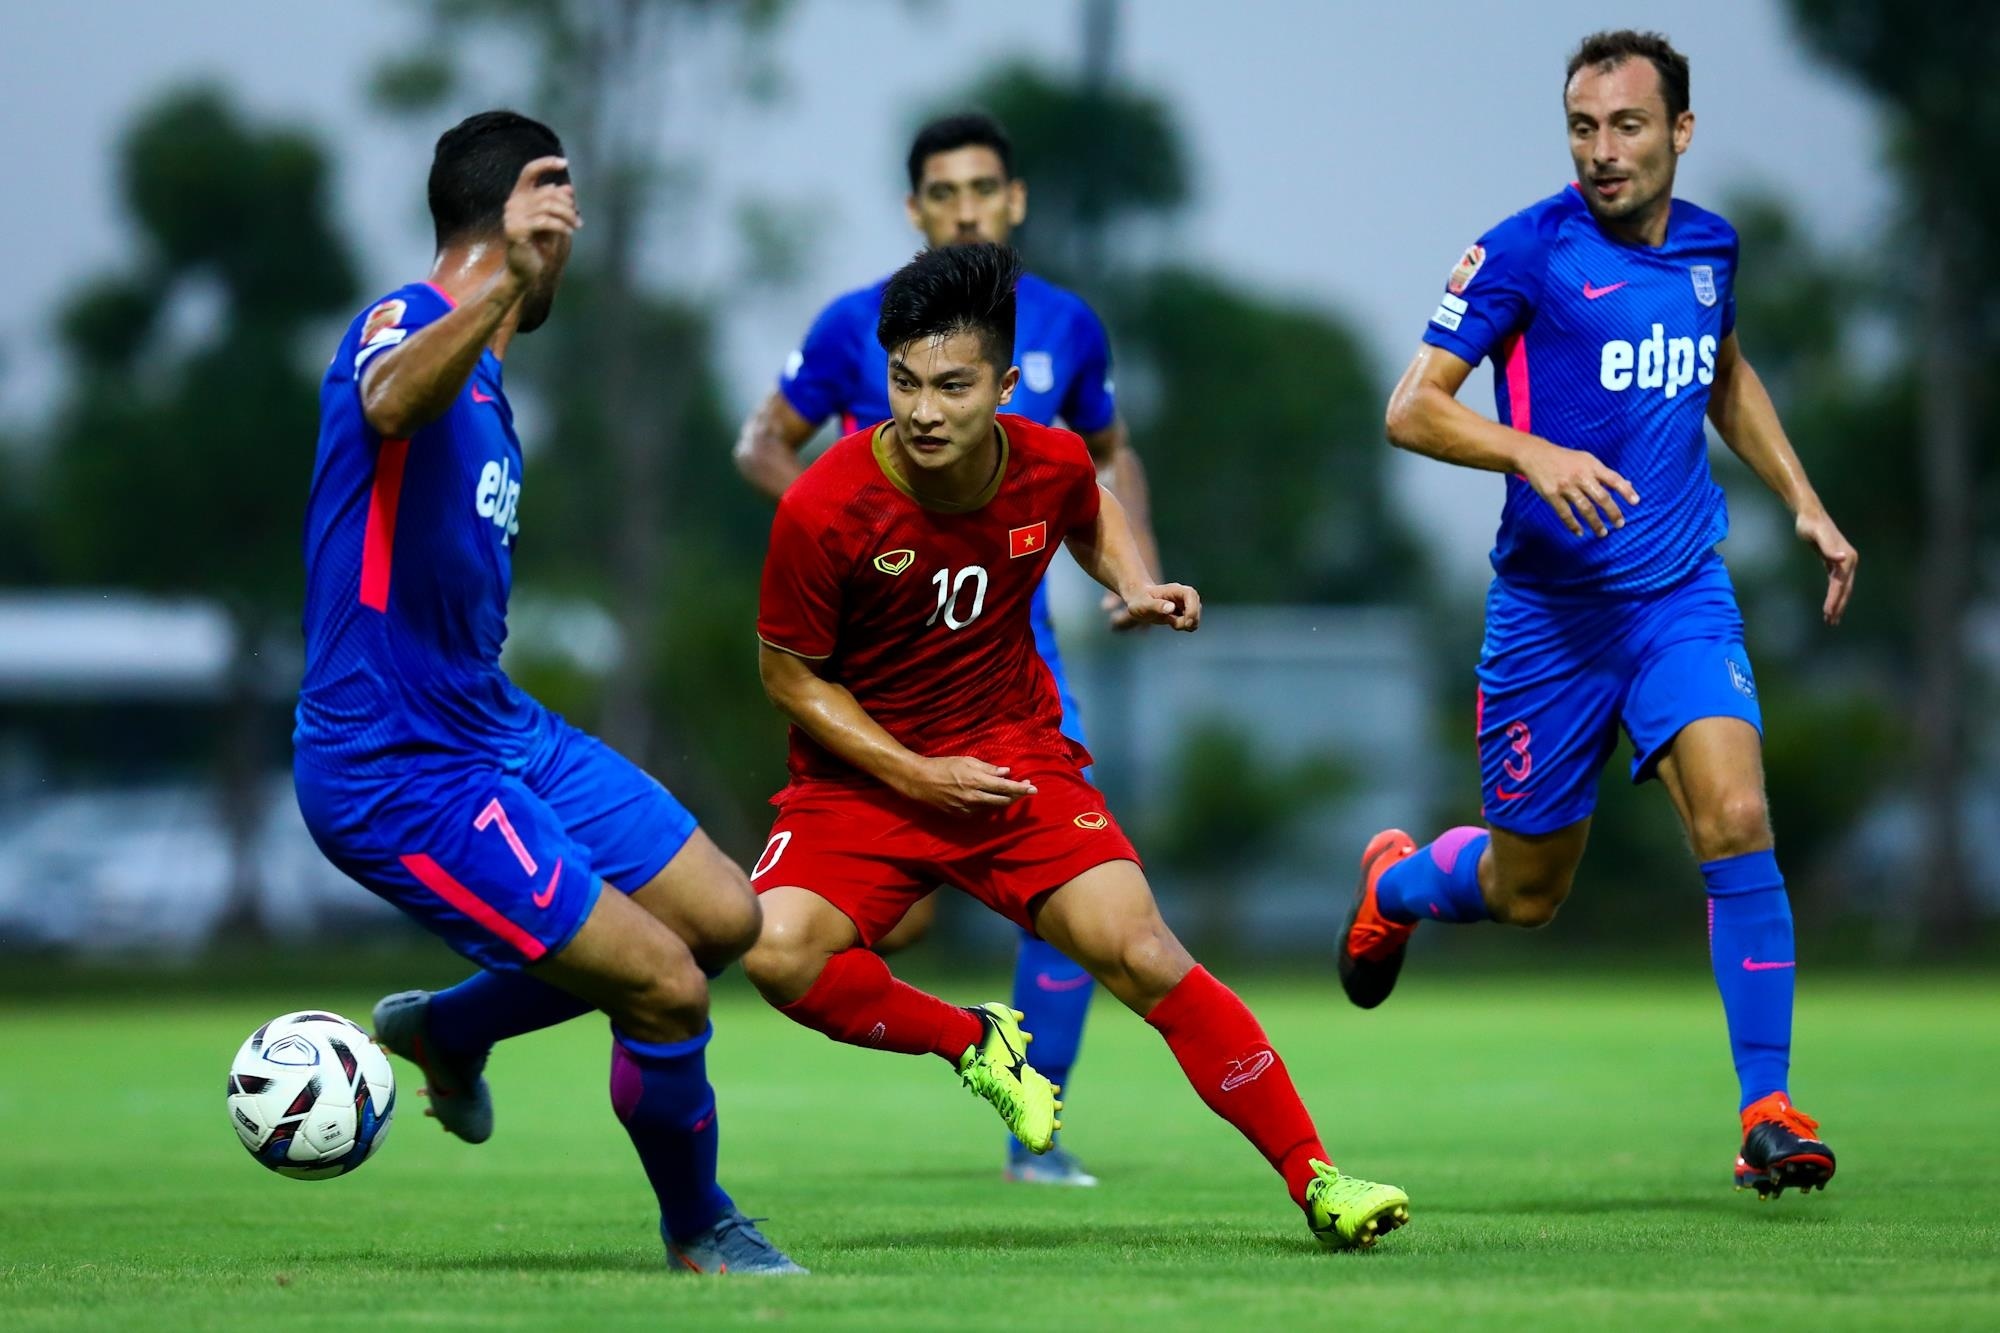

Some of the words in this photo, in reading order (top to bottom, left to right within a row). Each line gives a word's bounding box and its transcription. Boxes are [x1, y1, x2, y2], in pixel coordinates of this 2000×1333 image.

[1600, 323, 1717, 399] edps
[926, 565, 988, 631] 10
[1503, 720, 1532, 782] 3
[473, 797, 538, 878] 7
